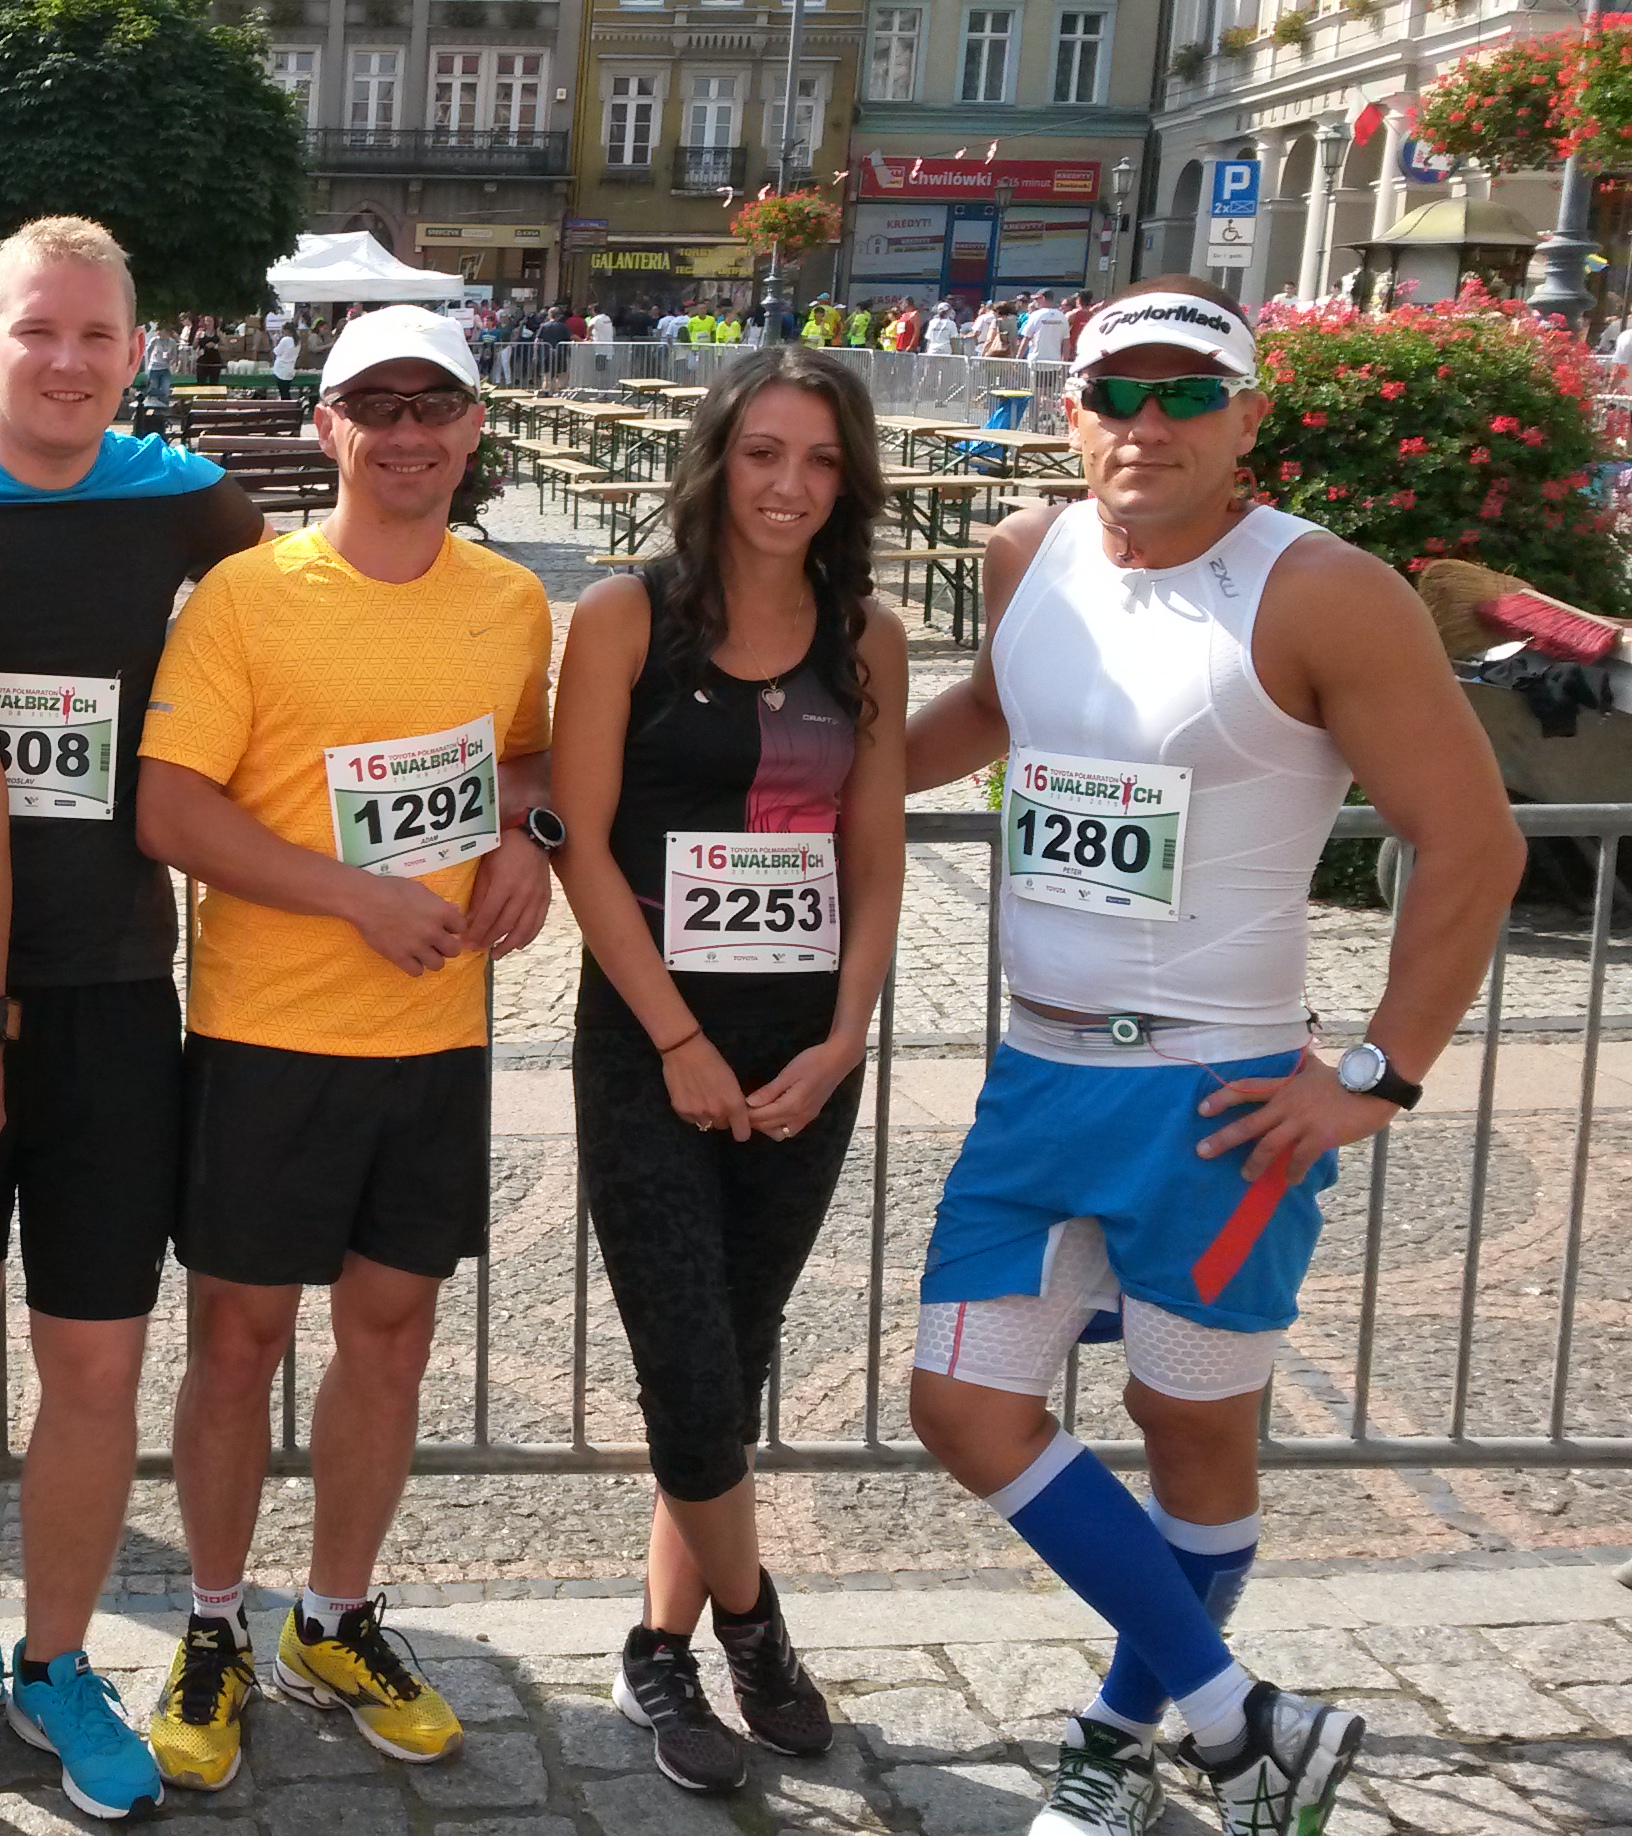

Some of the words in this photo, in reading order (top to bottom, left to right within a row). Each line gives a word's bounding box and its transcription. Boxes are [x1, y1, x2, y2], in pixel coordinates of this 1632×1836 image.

[1235, 85, 1349, 131] BIBLIOTEK
[909, 170, 992, 187] Chwilówki
[1223, 165, 1251, 199] P
[887, 218, 932, 230] KREDYT!
[591, 252, 671, 270] GALANTERIA
[1099, 304, 1232, 336] TaylorMade
[802, 713, 833, 725] CRAFT
[6, 777, 35, 785] ROSLAV
[348, 754, 388, 783] 16
[1024, 763, 1049, 792] 16
[353, 775, 484, 846] 1292
[421, 834, 439, 845] ADAM
[1017, 808, 1152, 874] 1280
[689, 844, 728, 870] 16
[1063, 866, 1083, 876] PETER
[683, 886, 823, 933] 2253
